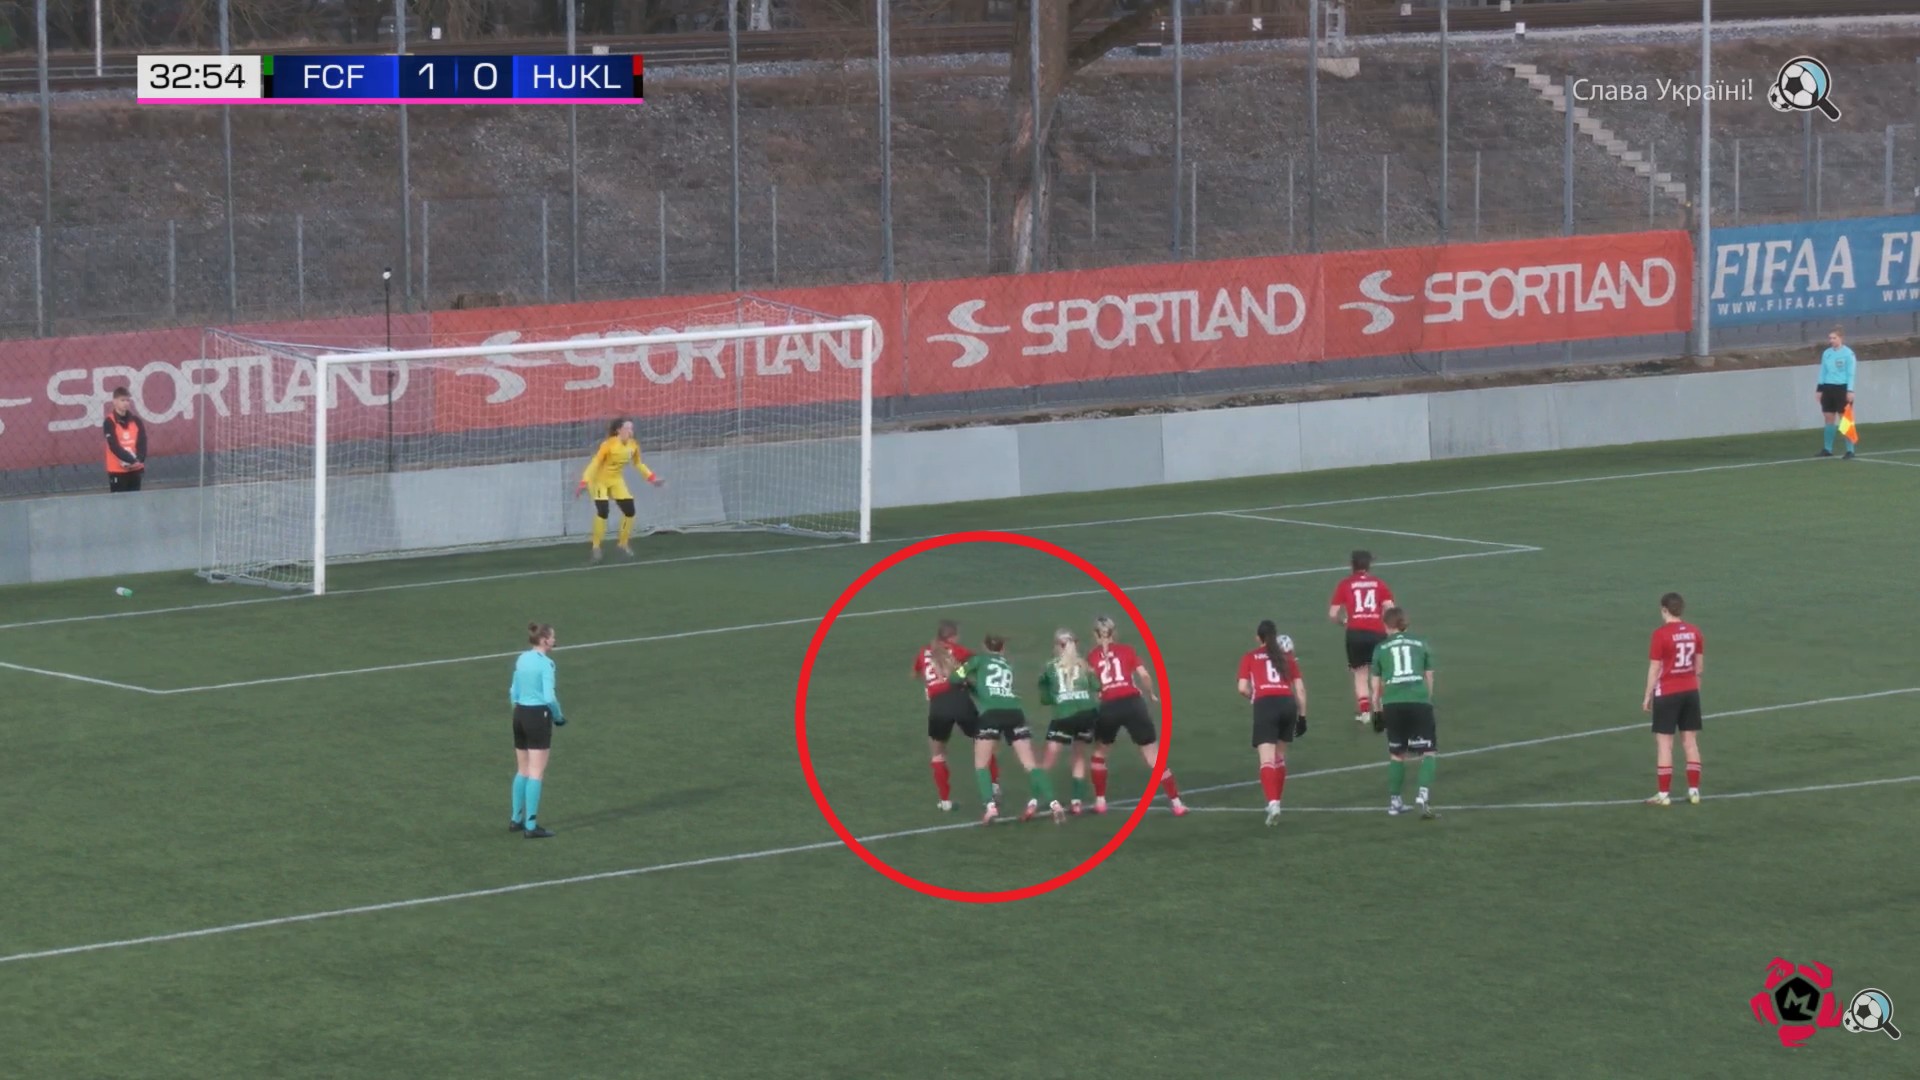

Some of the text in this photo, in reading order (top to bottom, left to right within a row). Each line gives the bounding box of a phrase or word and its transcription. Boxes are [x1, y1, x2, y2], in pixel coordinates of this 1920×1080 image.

[1711, 235, 1856, 299] FIFAA
[1424, 257, 1677, 323] SPORTLAND
[1717, 294, 1845, 316] WWW.FIFAA.EE
[1021, 283, 1307, 356] SPORTLAND
[1353, 589, 1377, 613] 14
[1098, 657, 1124, 684] 21
[1391, 646, 1413, 676] 11
